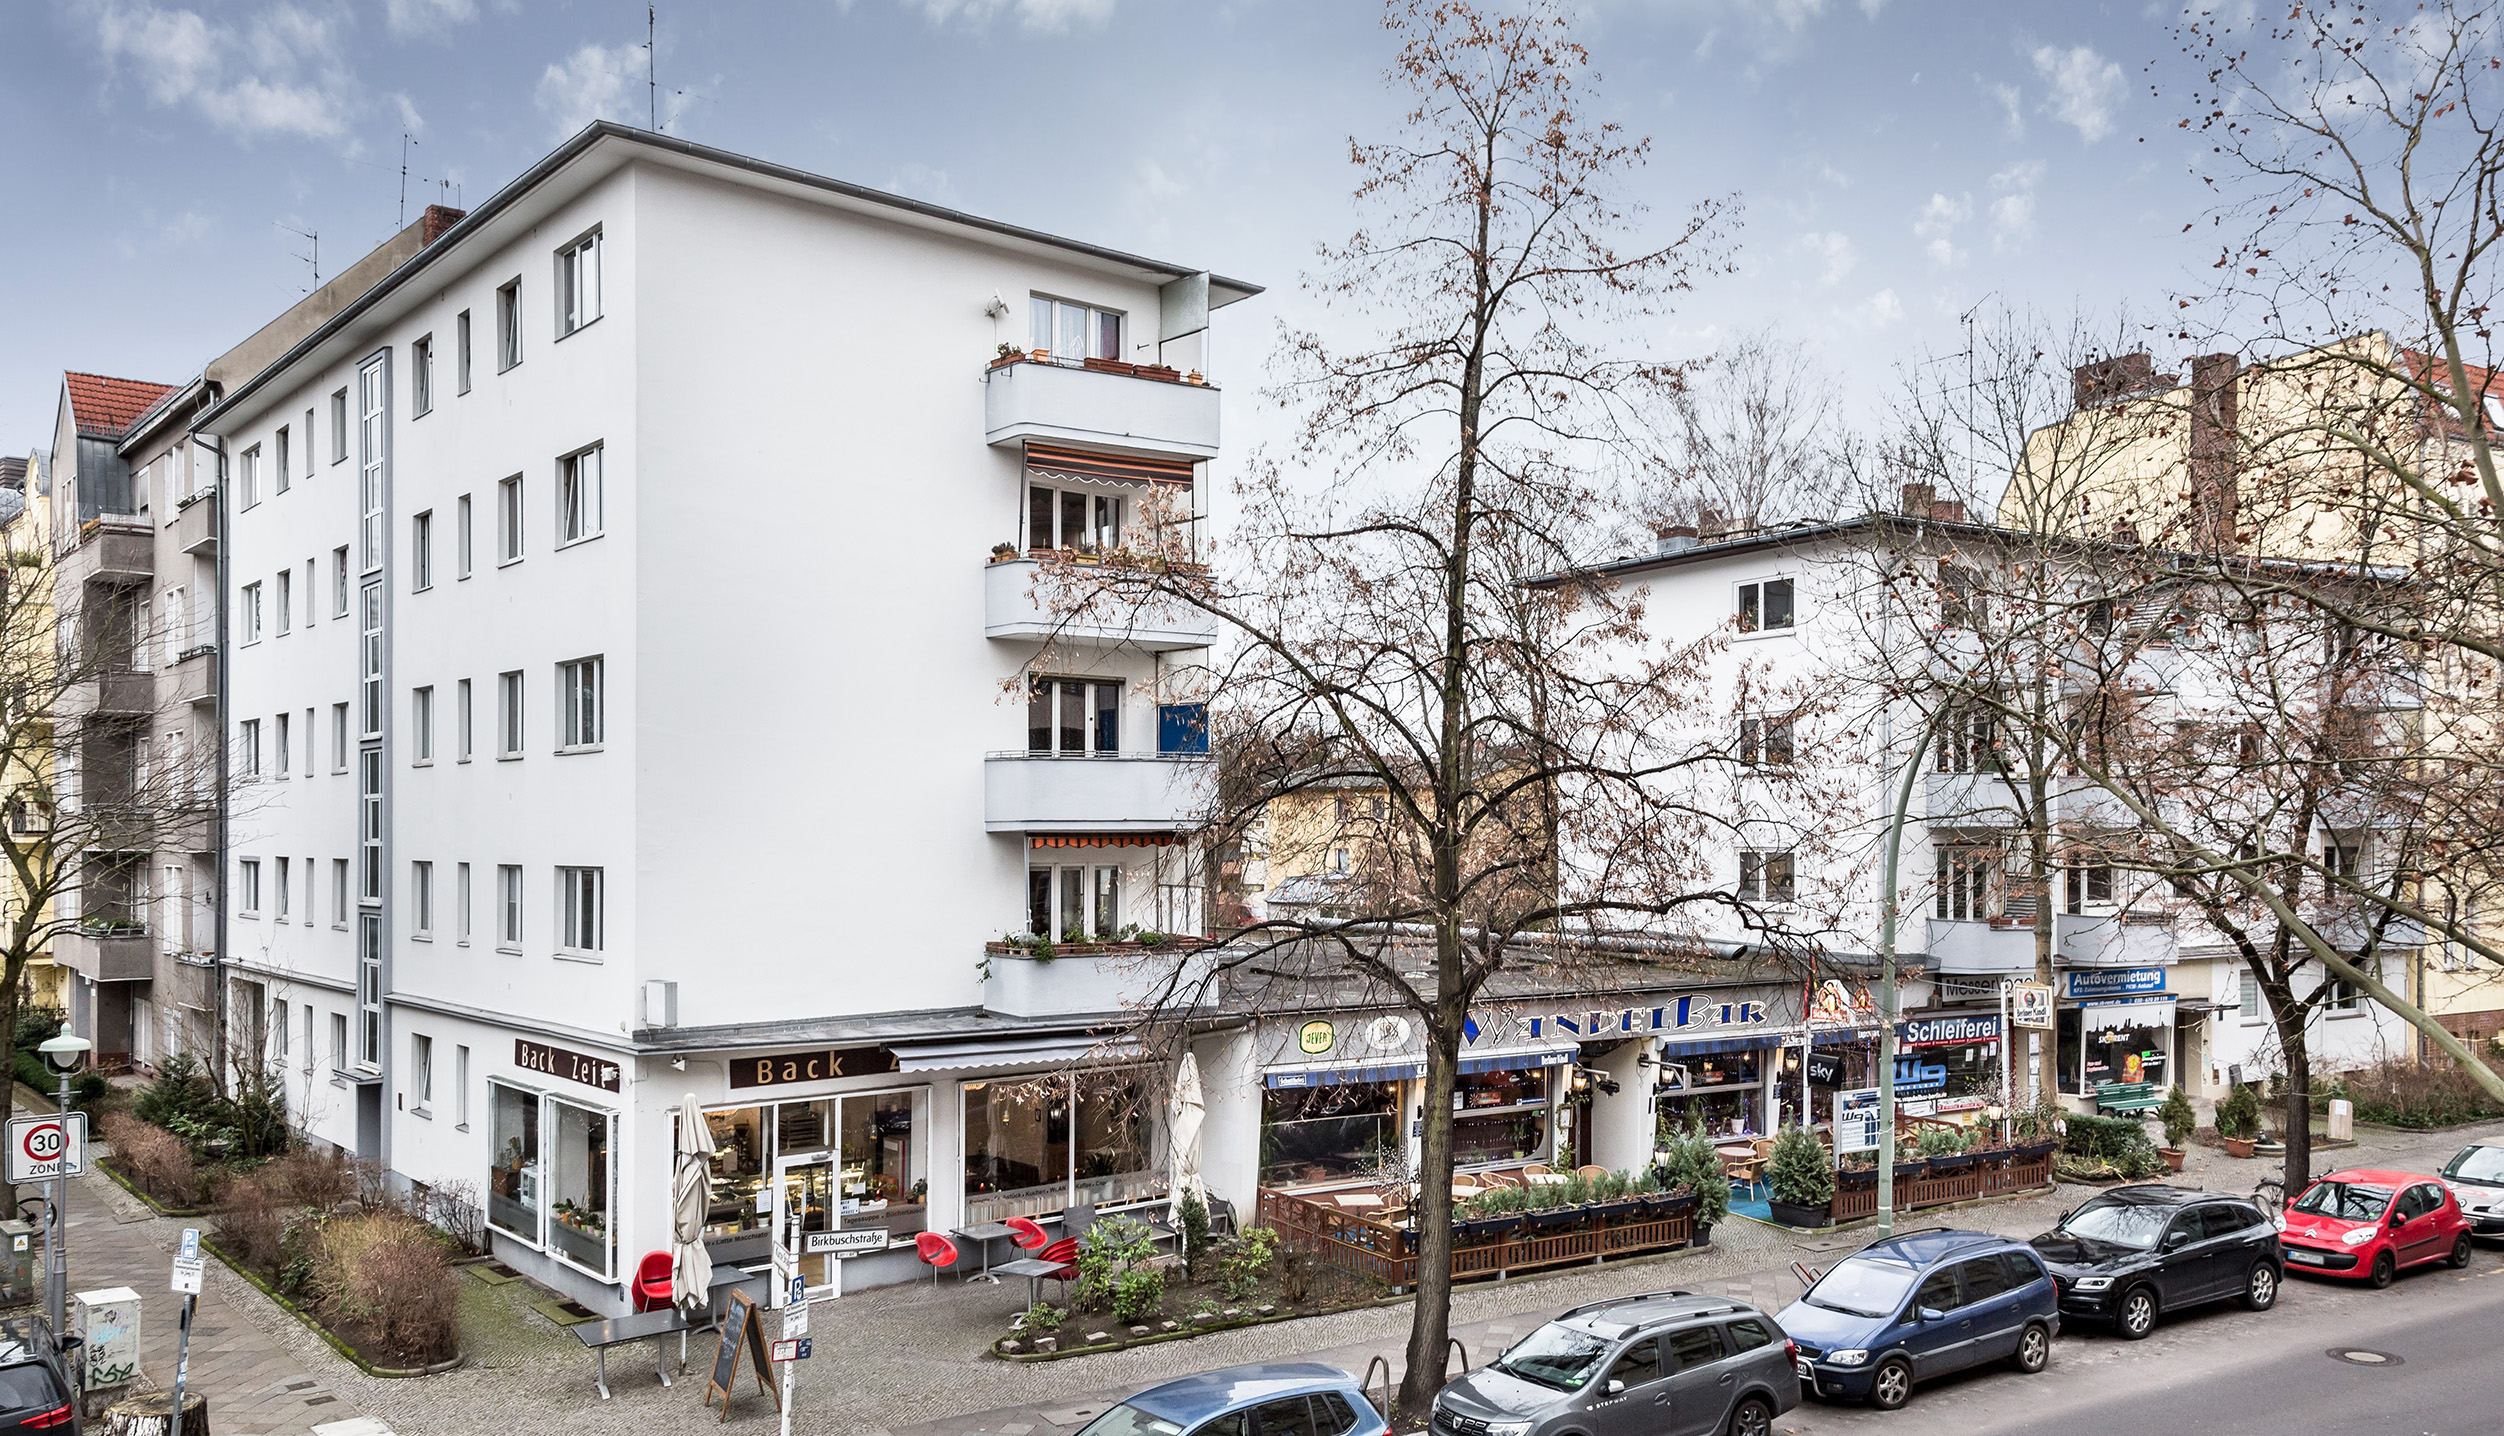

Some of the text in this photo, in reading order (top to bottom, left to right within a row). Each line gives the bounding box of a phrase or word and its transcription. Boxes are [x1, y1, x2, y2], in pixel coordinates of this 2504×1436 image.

[2073, 971, 2161, 986] Autovermietung
[1906, 1016, 1997, 1043] Schleiferei
[1306, 1031, 1328, 1045] JEVER
[521, 1043, 555, 1073] Back
[757, 1050, 844, 1084] Back
[1810, 1062, 1834, 1082] sky
[1896, 1082, 1939, 1091] ANDELBAR
[33, 1133, 60, 1152] 30
[843, 1214, 880, 1225] Tagessuppe
[716, 1236, 733, 1245] Latte
[735, 1231, 768, 1242] Macchiato
[811, 1231, 883, 1247] Birkbuschstraße
[793, 1279, 802, 1300] P
[1595, 1396, 1628, 1409] STEPWAY
